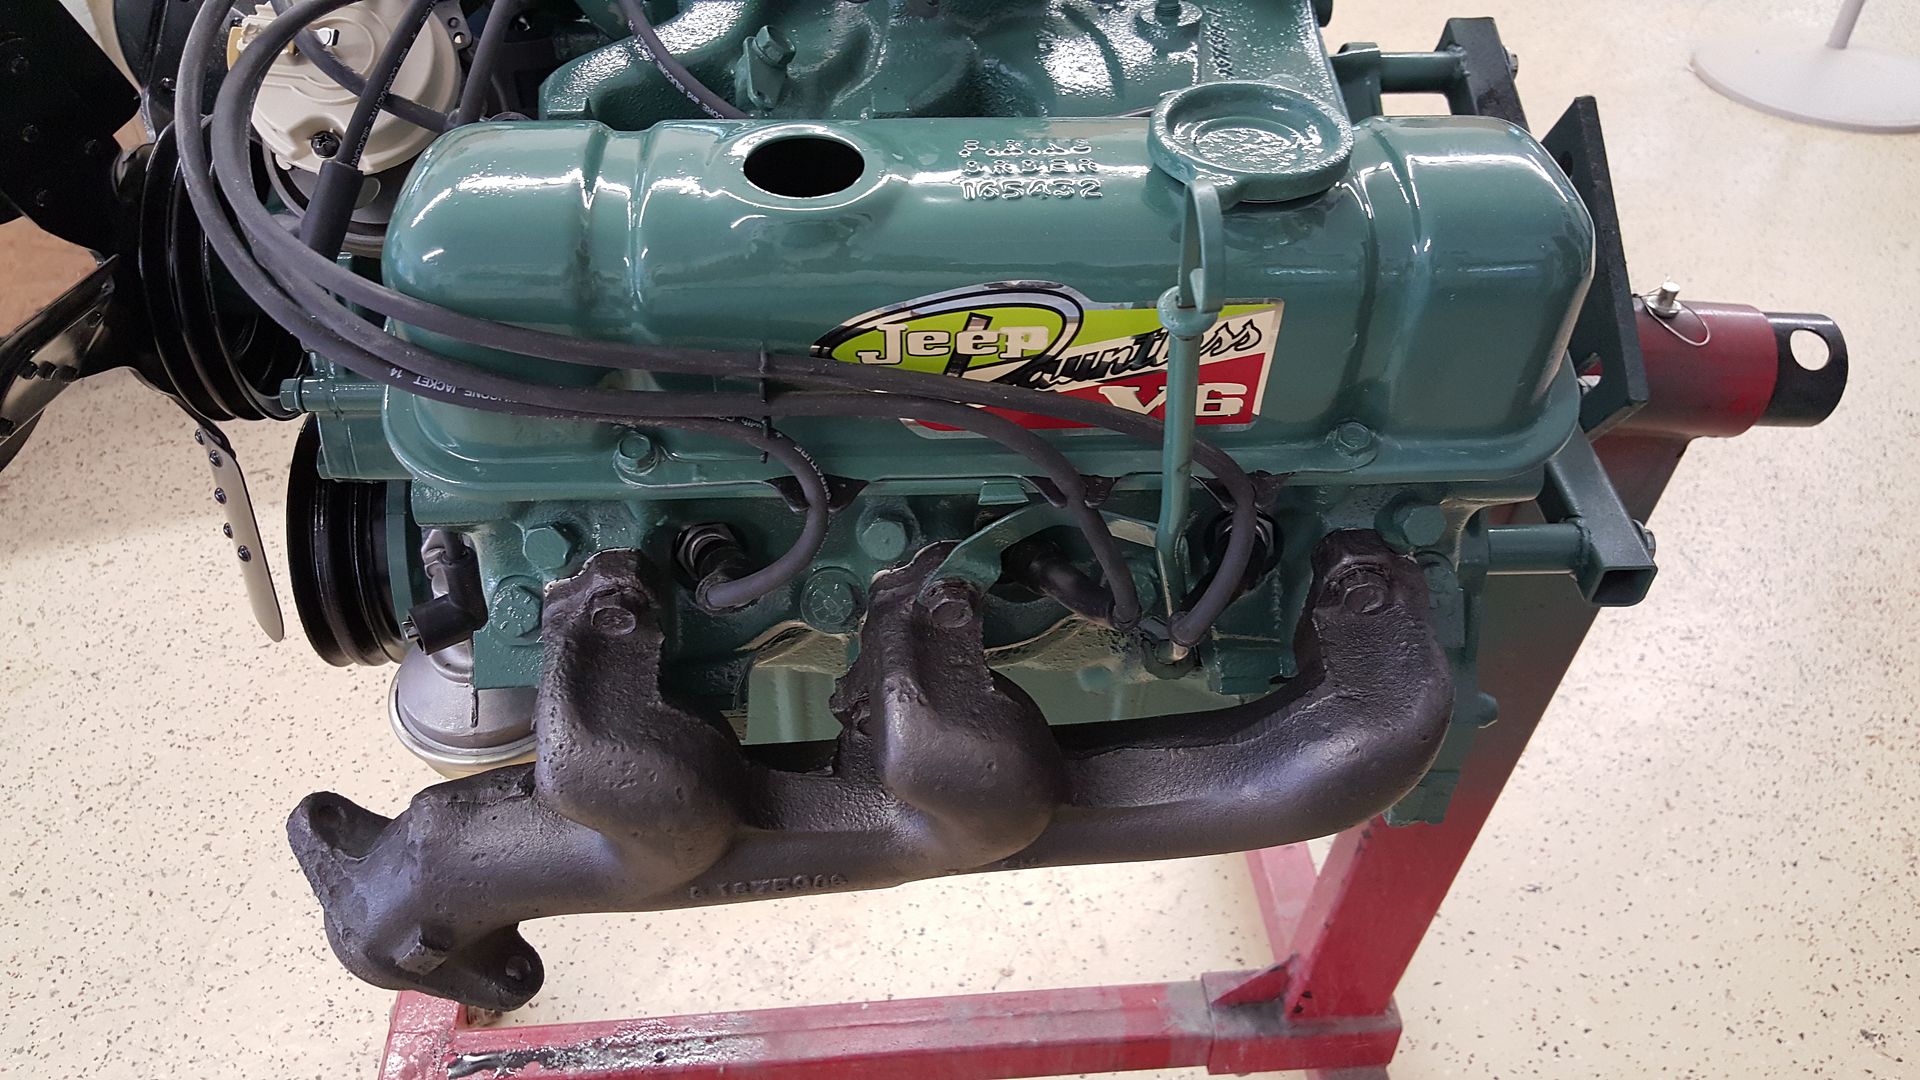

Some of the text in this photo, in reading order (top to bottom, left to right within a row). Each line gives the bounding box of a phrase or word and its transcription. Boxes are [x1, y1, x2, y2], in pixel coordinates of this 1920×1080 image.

[368, 66, 399, 122] CONDUCTIVE
[961, 158, 1100, 176] ORDER
[959, 178, 1103, 200] 165432
[856, 322, 1050, 365] Jeep
[389, 366, 403, 379] 14
[412, 374, 457, 394] JACKET
[1098, 381, 1248, 417] V6
